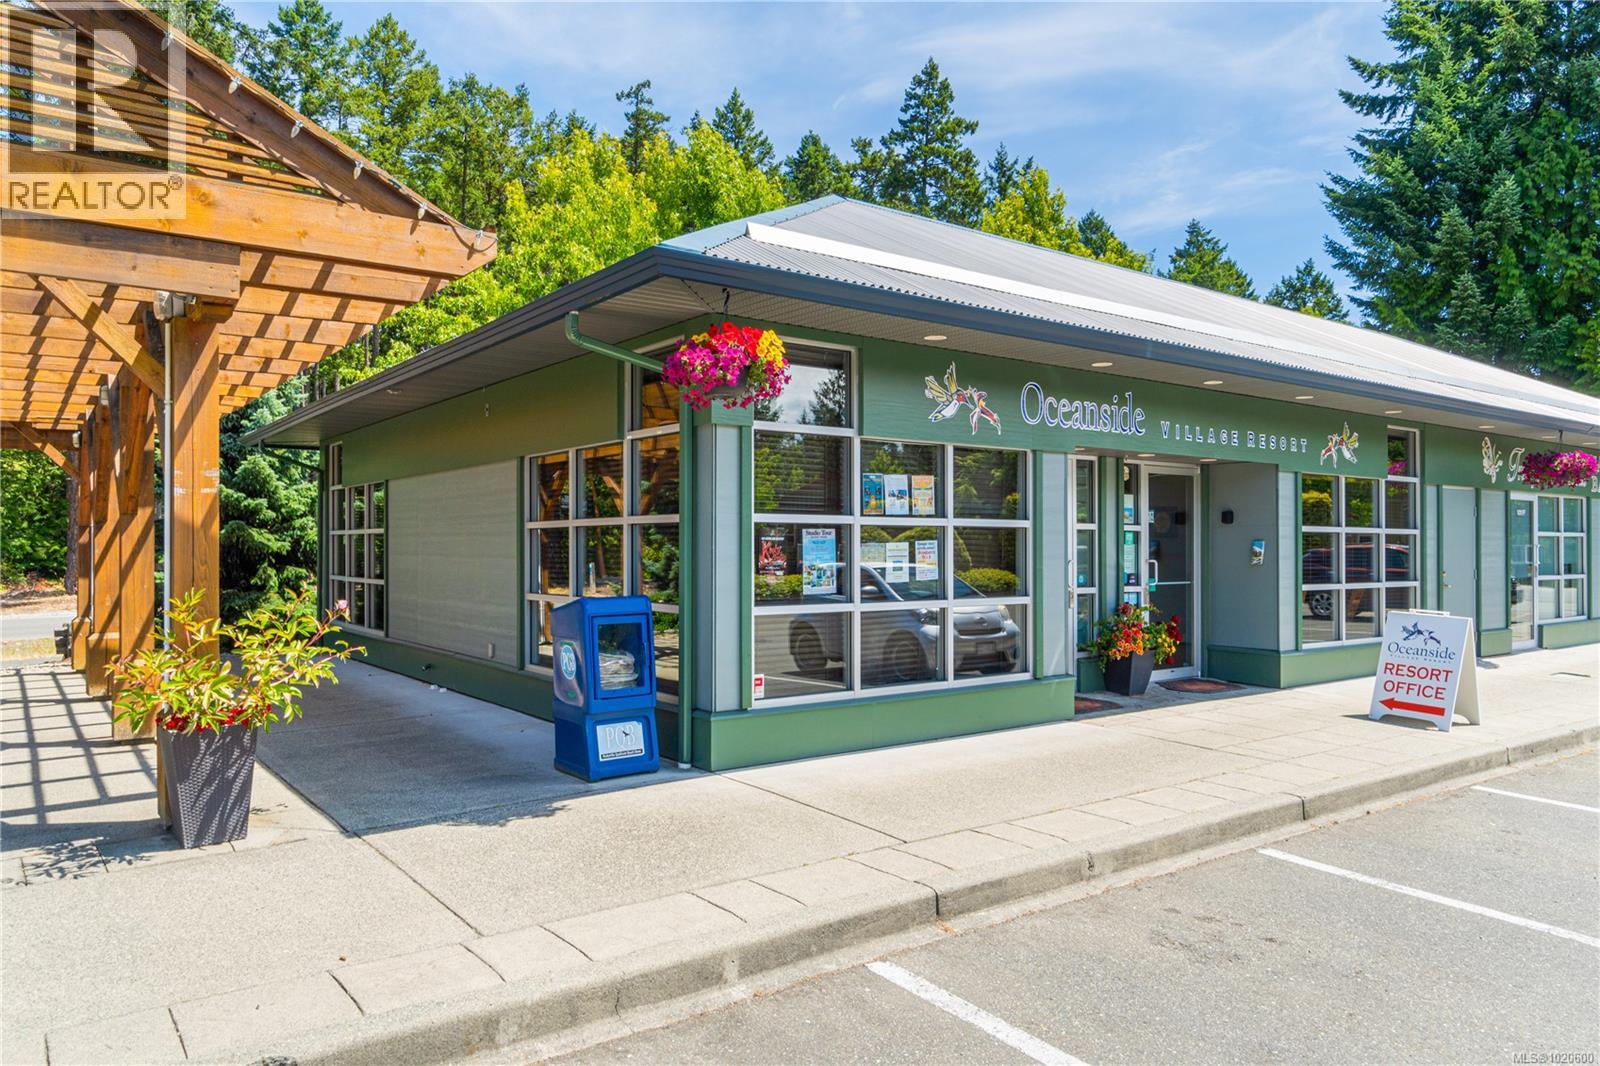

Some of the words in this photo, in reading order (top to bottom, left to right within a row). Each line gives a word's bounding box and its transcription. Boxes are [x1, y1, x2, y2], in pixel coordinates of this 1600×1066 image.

[1020, 381, 1146, 436] Oceanside
[1160, 420, 1239, 447] VILLAGE
[1247, 430, 1308, 454] RESORT
[1387, 641, 1456, 660] Oceanside
[1383, 662, 1453, 683] RESORT
[1383, 680, 1446, 700] OFFICE
